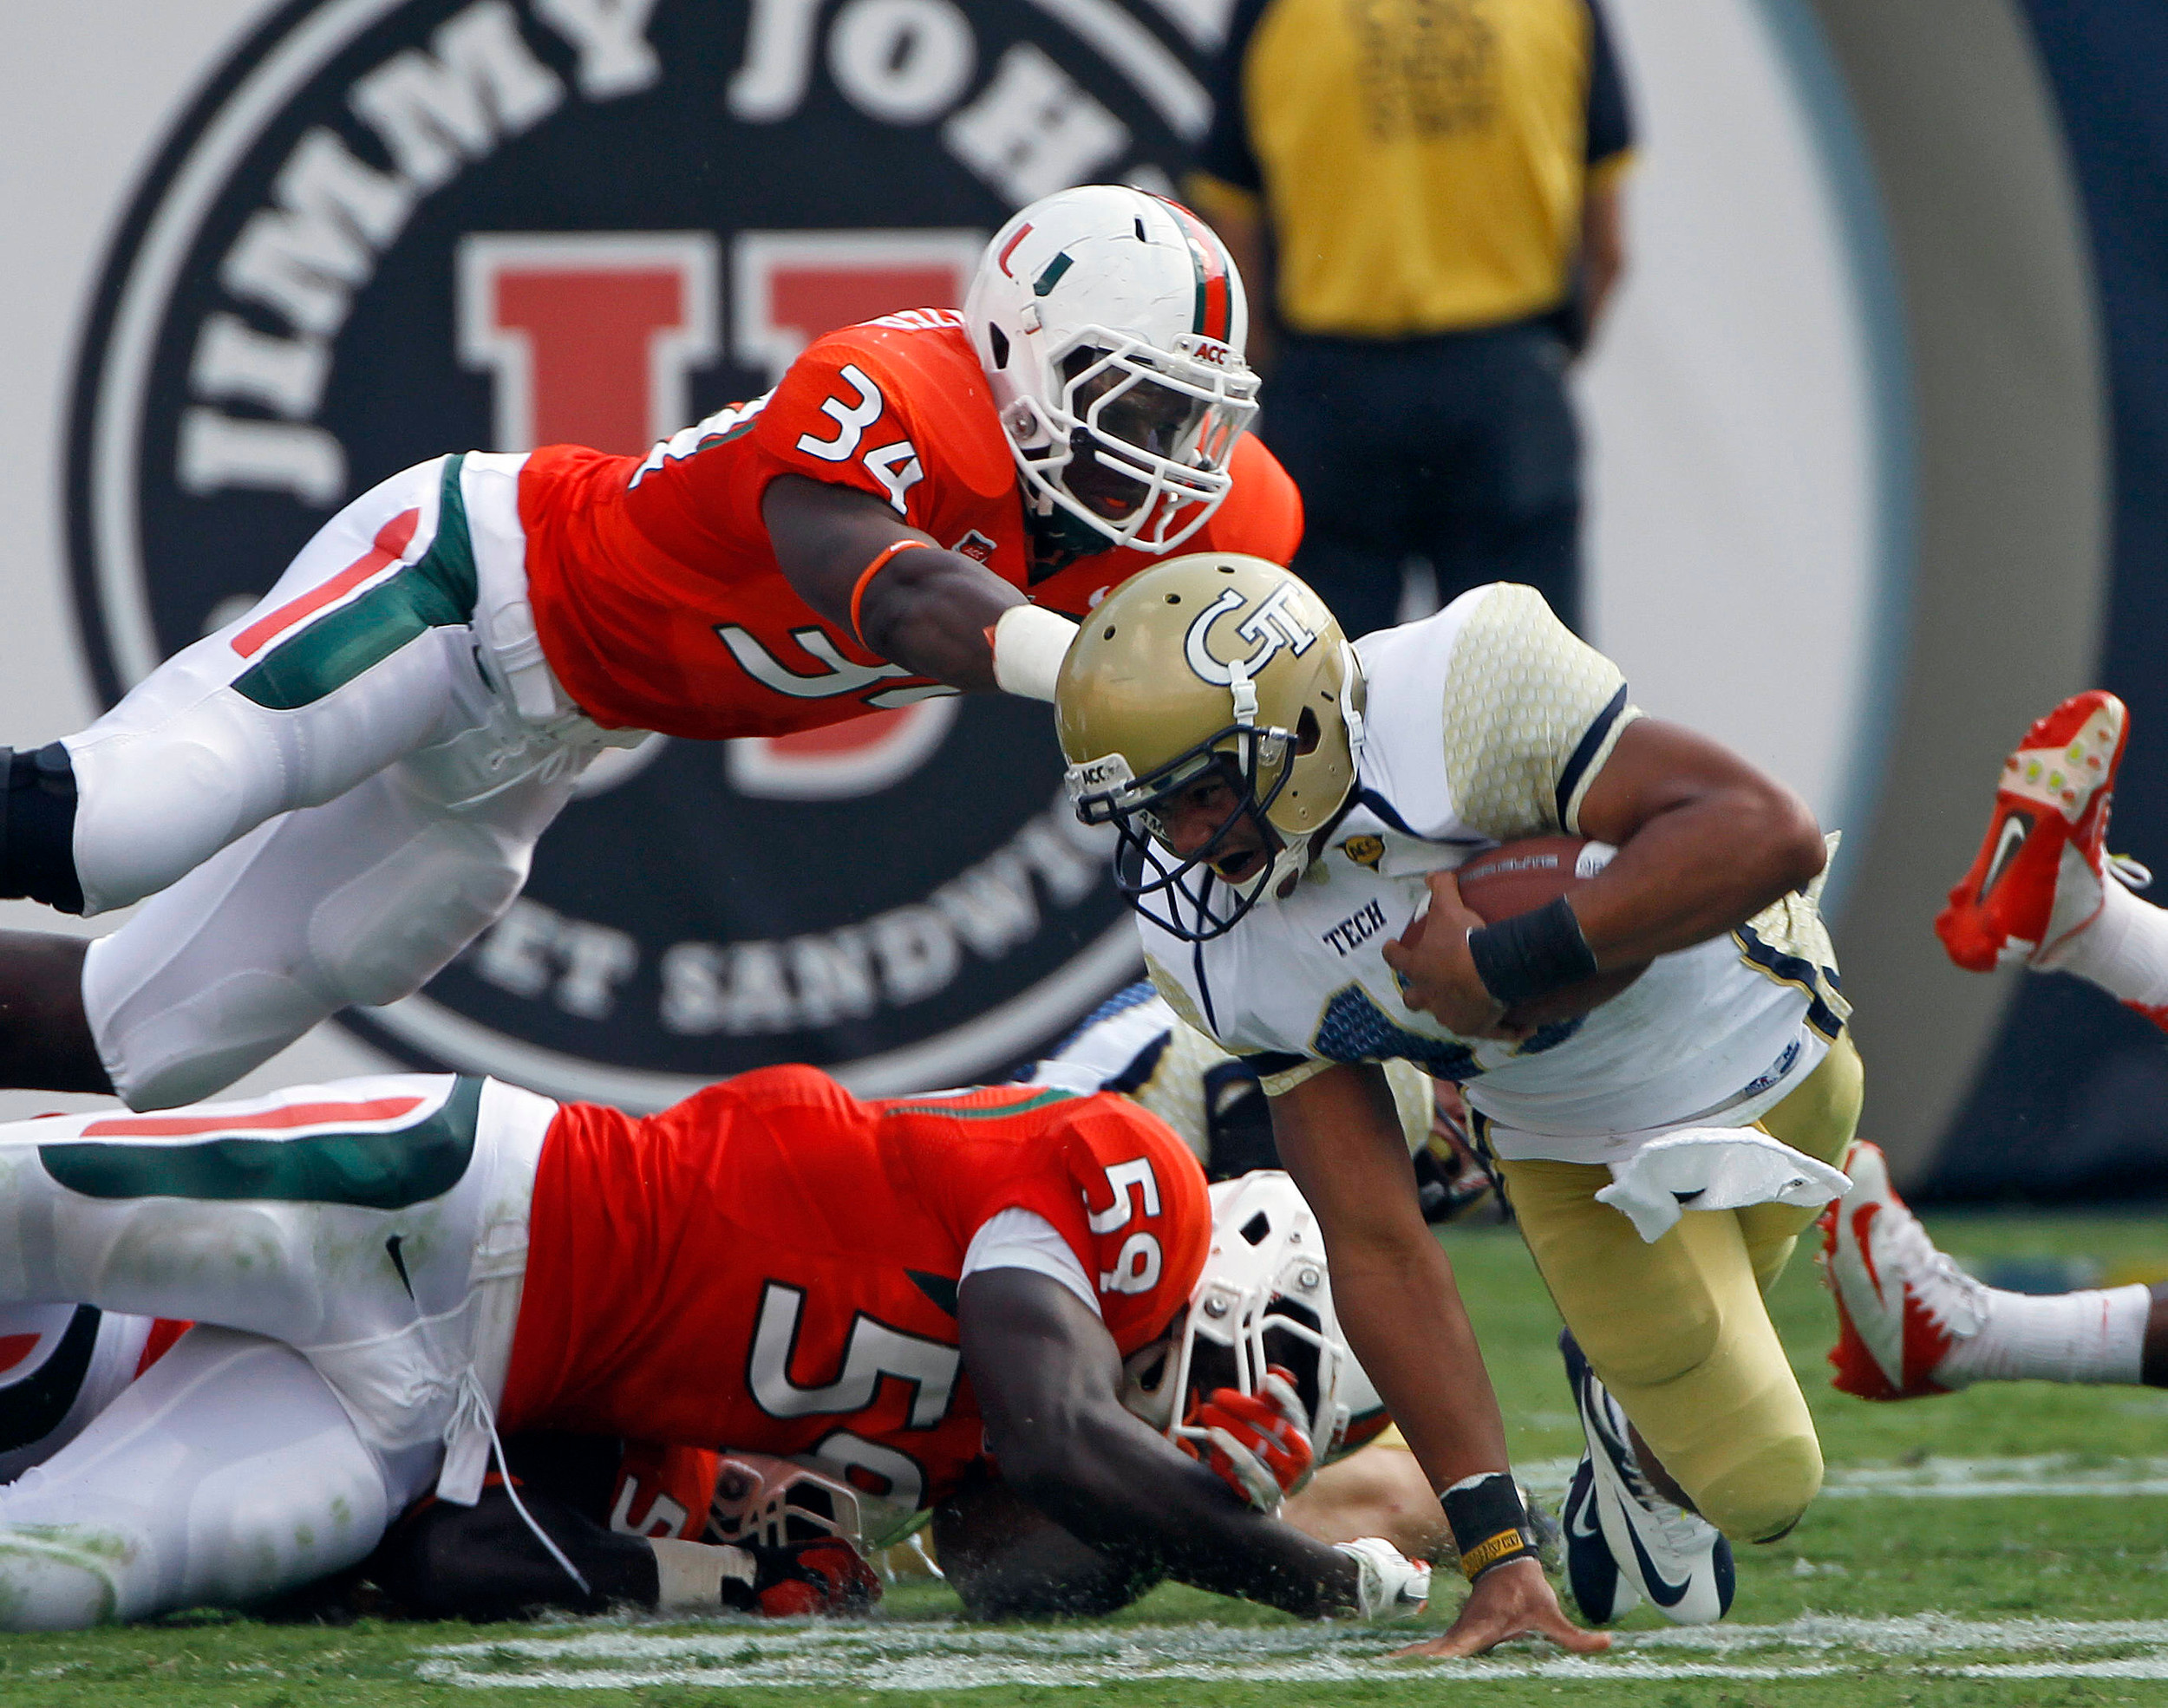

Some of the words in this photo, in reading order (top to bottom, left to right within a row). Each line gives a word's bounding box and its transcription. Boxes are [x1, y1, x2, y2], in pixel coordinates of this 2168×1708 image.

[176, 0, 661, 506] JIMMY
[724, 0, 1166, 212] JOH
[1193, 342, 1229, 365] ACC
[795, 362, 925, 518] 34
[1081, 765, 1107, 786] ACC
[477, 896, 639, 1021] ET
[1321, 896, 1388, 958] TECH
[1081, 1156, 1163, 1295] 59
